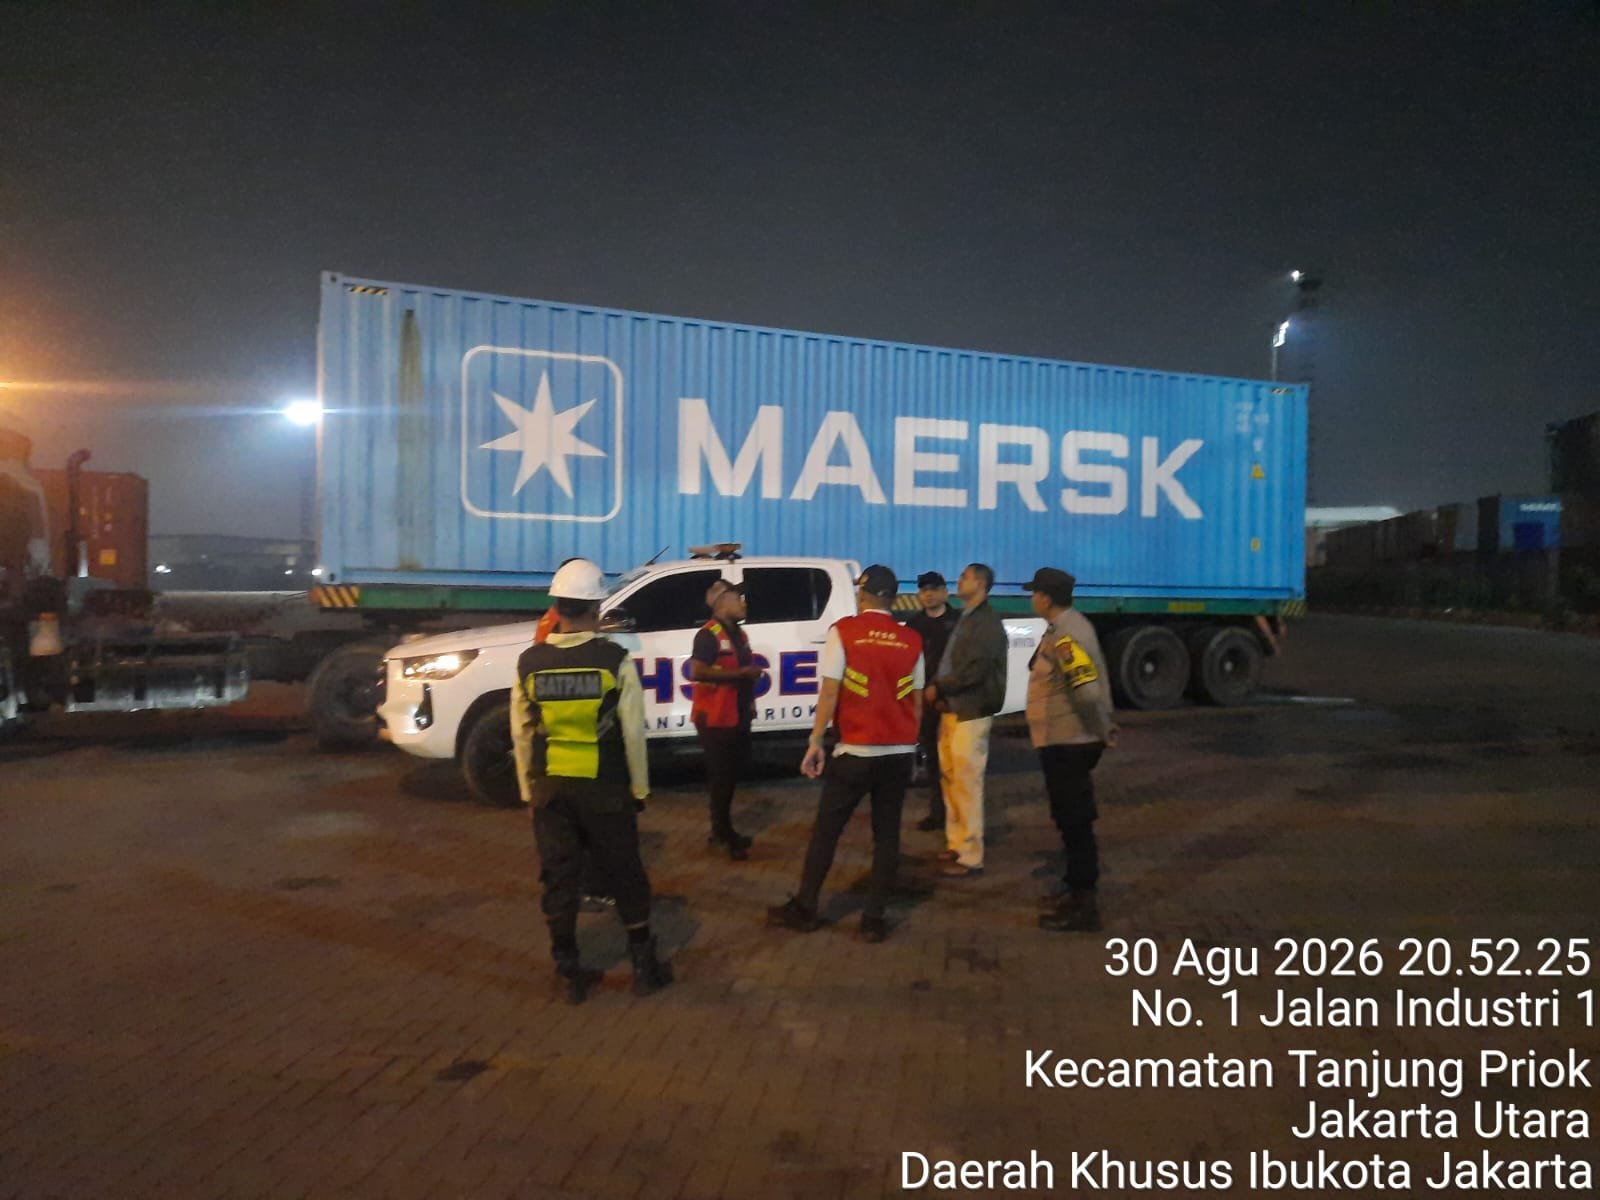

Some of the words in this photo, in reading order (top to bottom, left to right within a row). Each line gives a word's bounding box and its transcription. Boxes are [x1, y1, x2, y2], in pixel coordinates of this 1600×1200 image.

[677, 397, 1205, 520] MAERSK
[535, 672, 600, 699] SATPAM
[752, 704, 818, 721] RIOK
